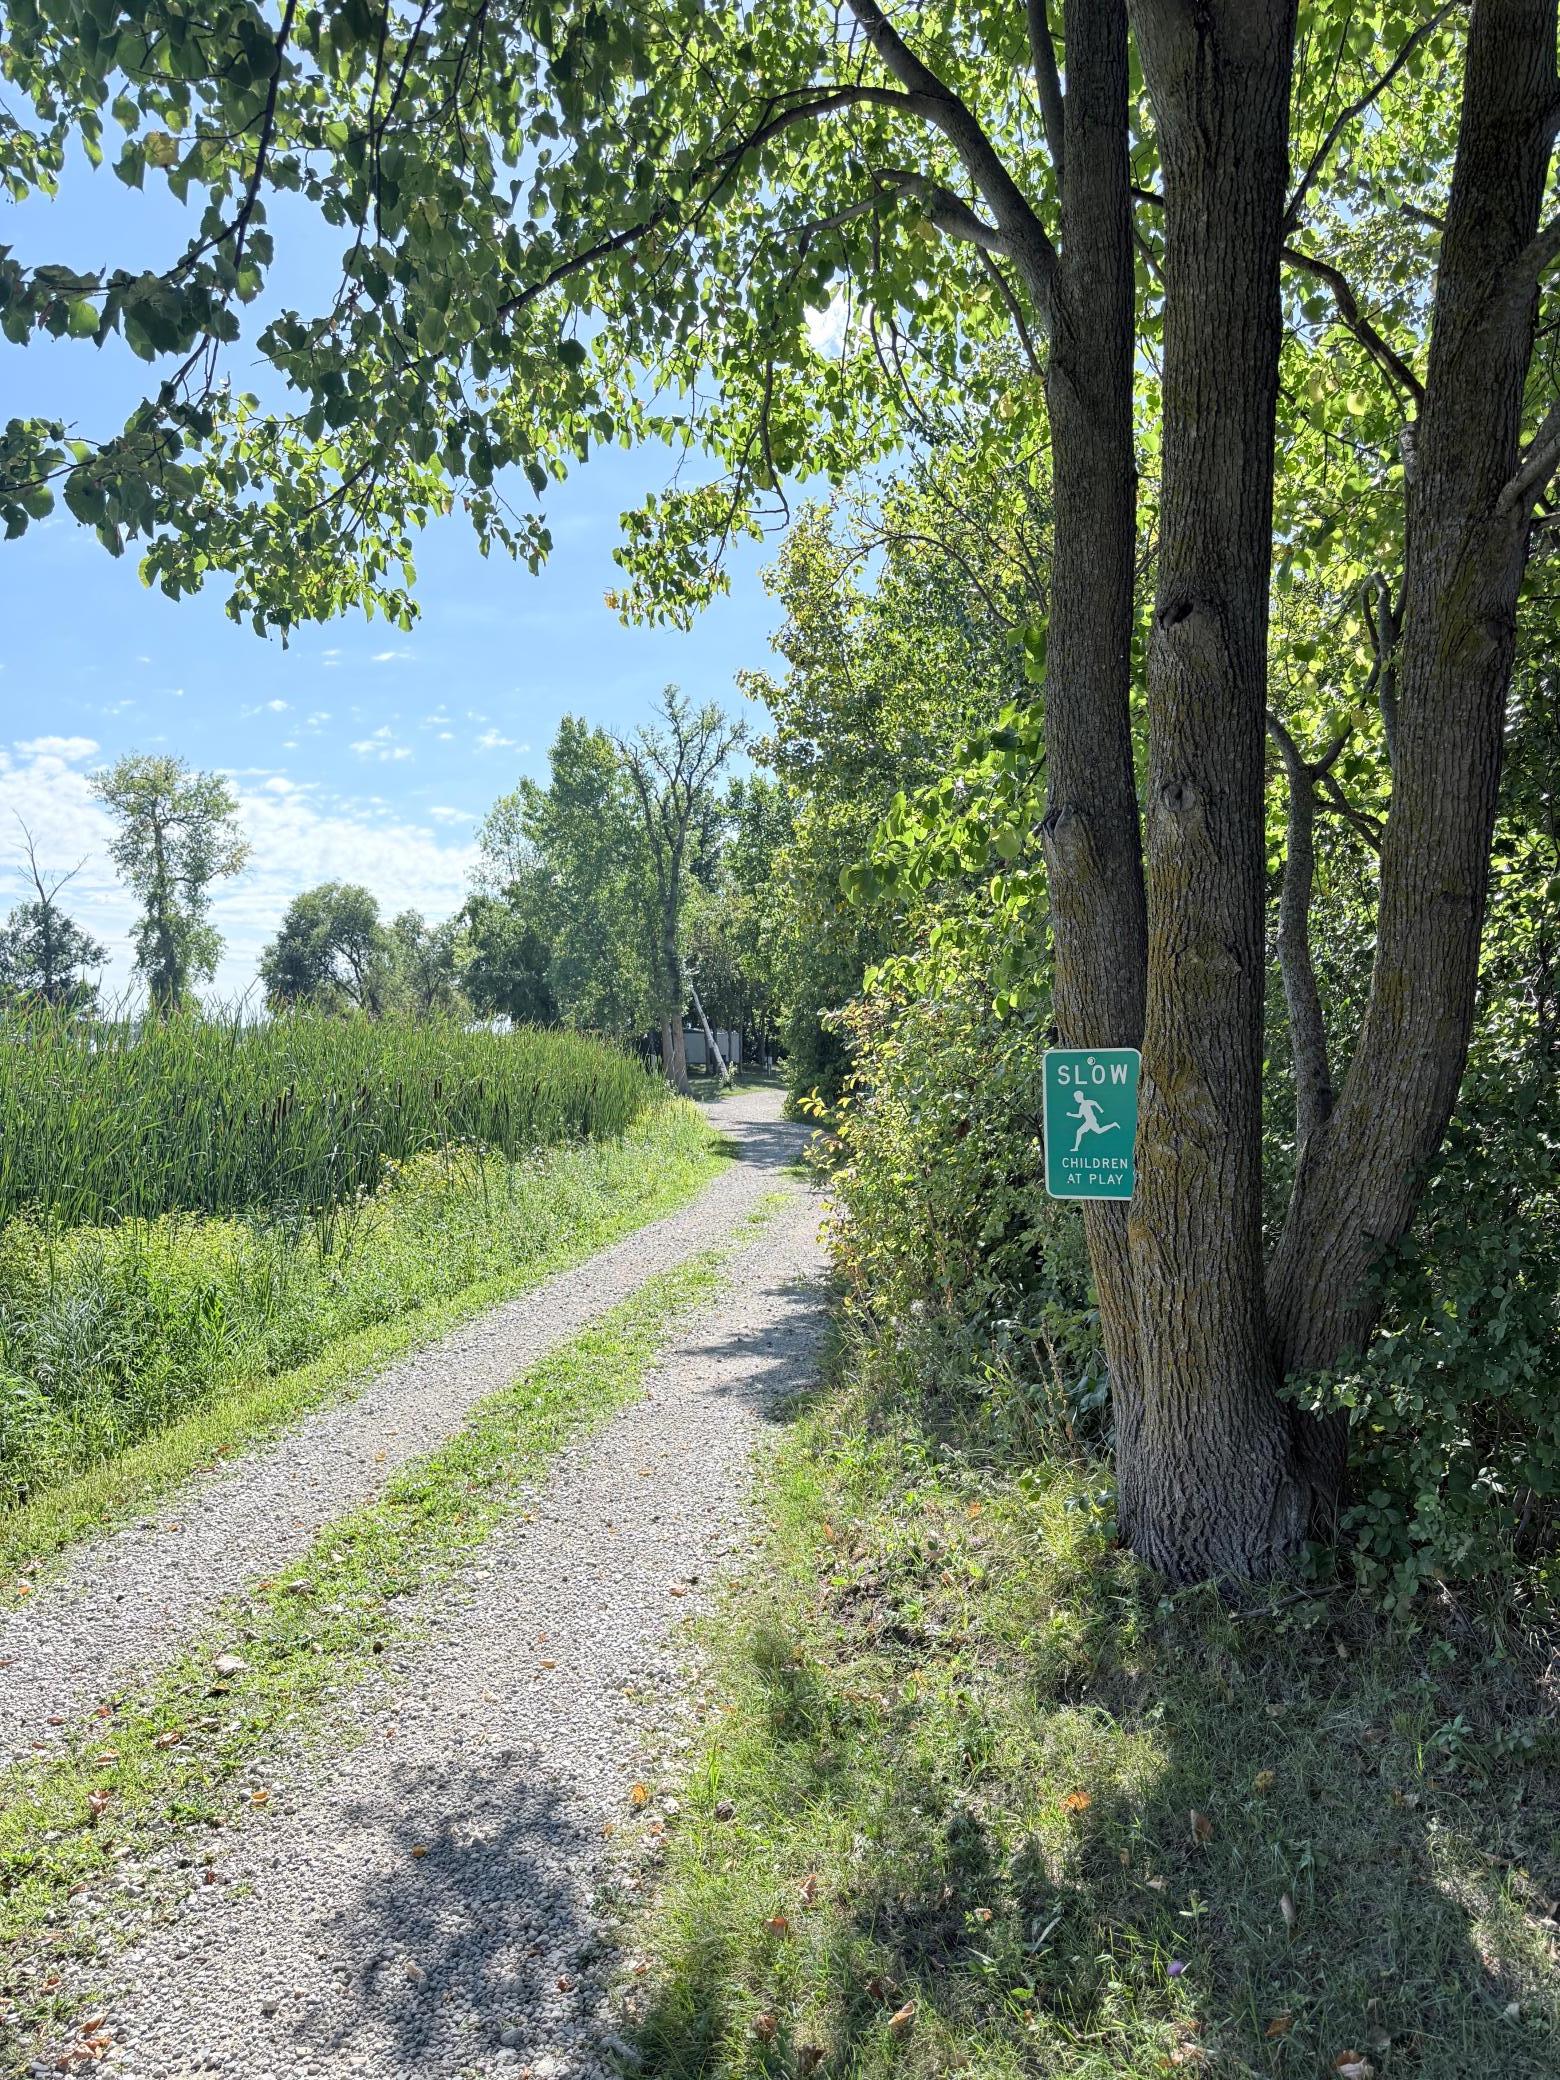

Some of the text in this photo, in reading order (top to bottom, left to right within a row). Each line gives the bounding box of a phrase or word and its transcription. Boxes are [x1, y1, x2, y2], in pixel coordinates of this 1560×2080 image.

[1057, 1064, 1128, 1085] SLOW
[1062, 1157, 1128, 1169] CHILDREN
[1066, 1173, 1124, 1185] AT PLAY
